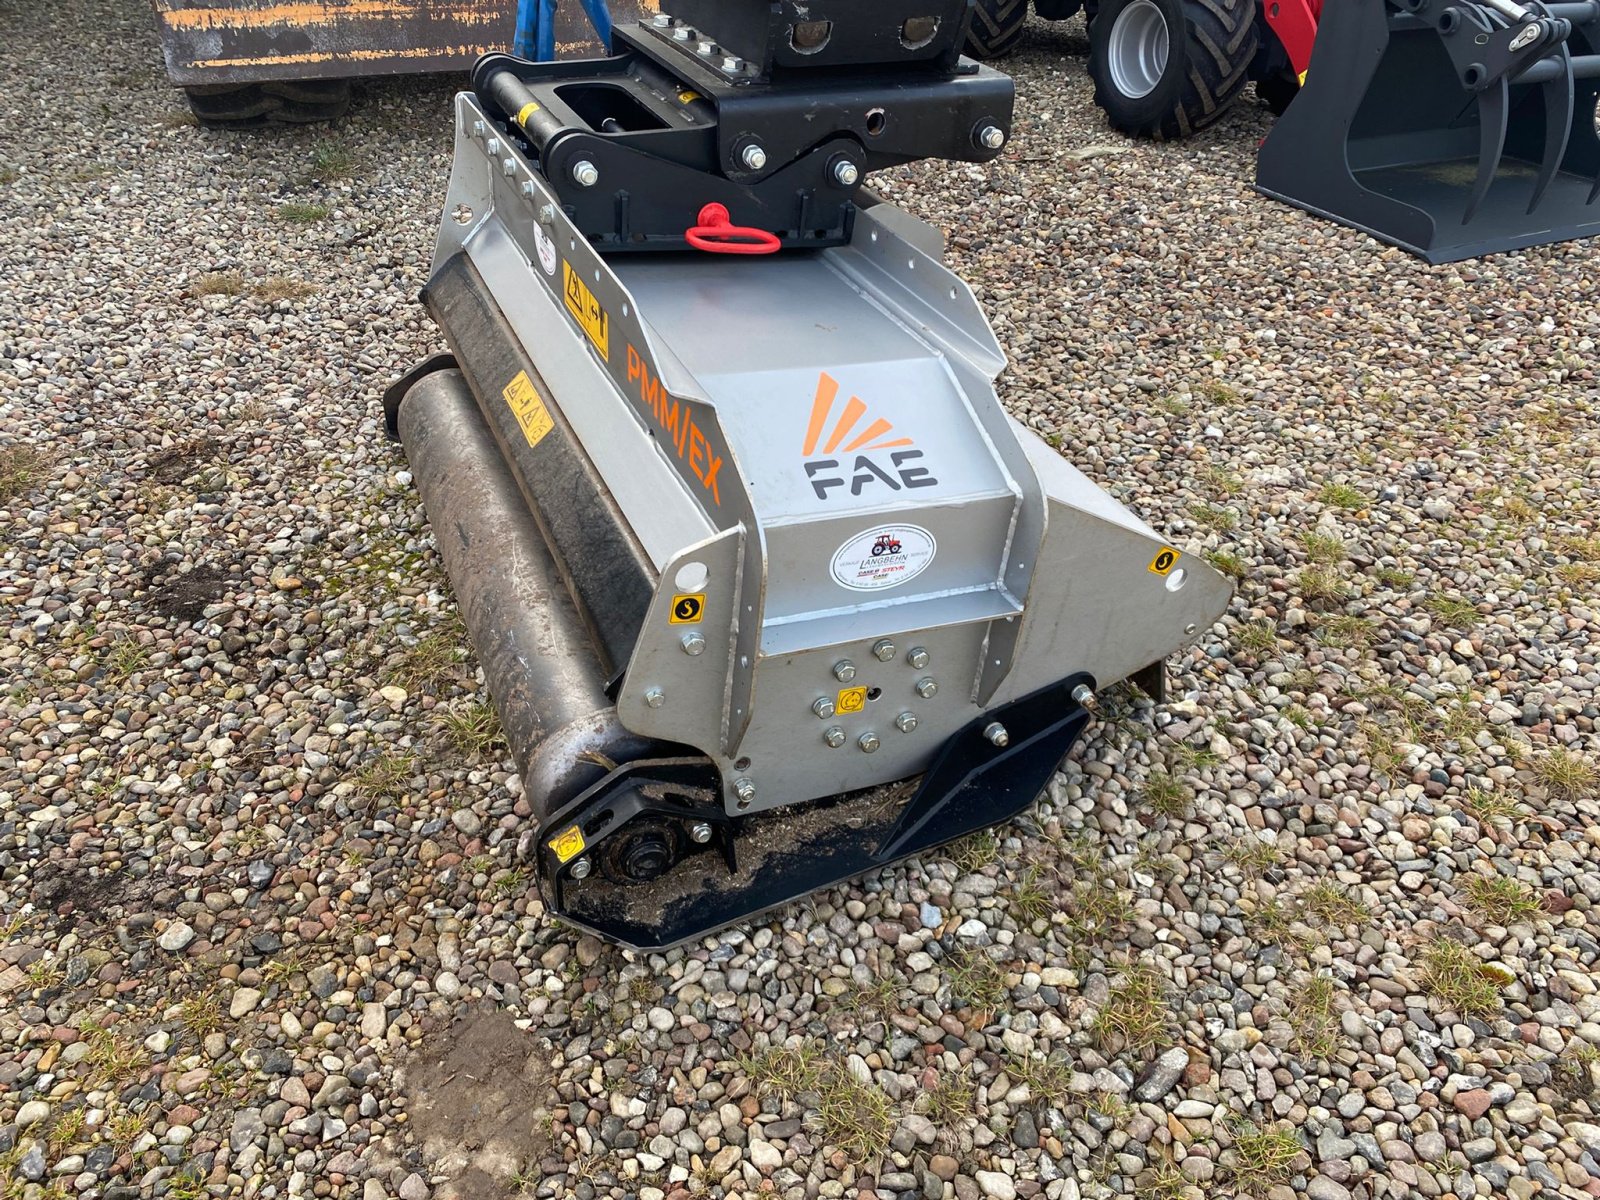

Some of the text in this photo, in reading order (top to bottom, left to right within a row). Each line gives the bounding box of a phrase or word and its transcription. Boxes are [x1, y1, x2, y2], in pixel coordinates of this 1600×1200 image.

[627, 343, 722, 507] PMM/EX
[803, 449, 939, 500] FAE
[859, 553, 908, 570] LANGBEHN
[880, 565, 905, 573] STEYR
